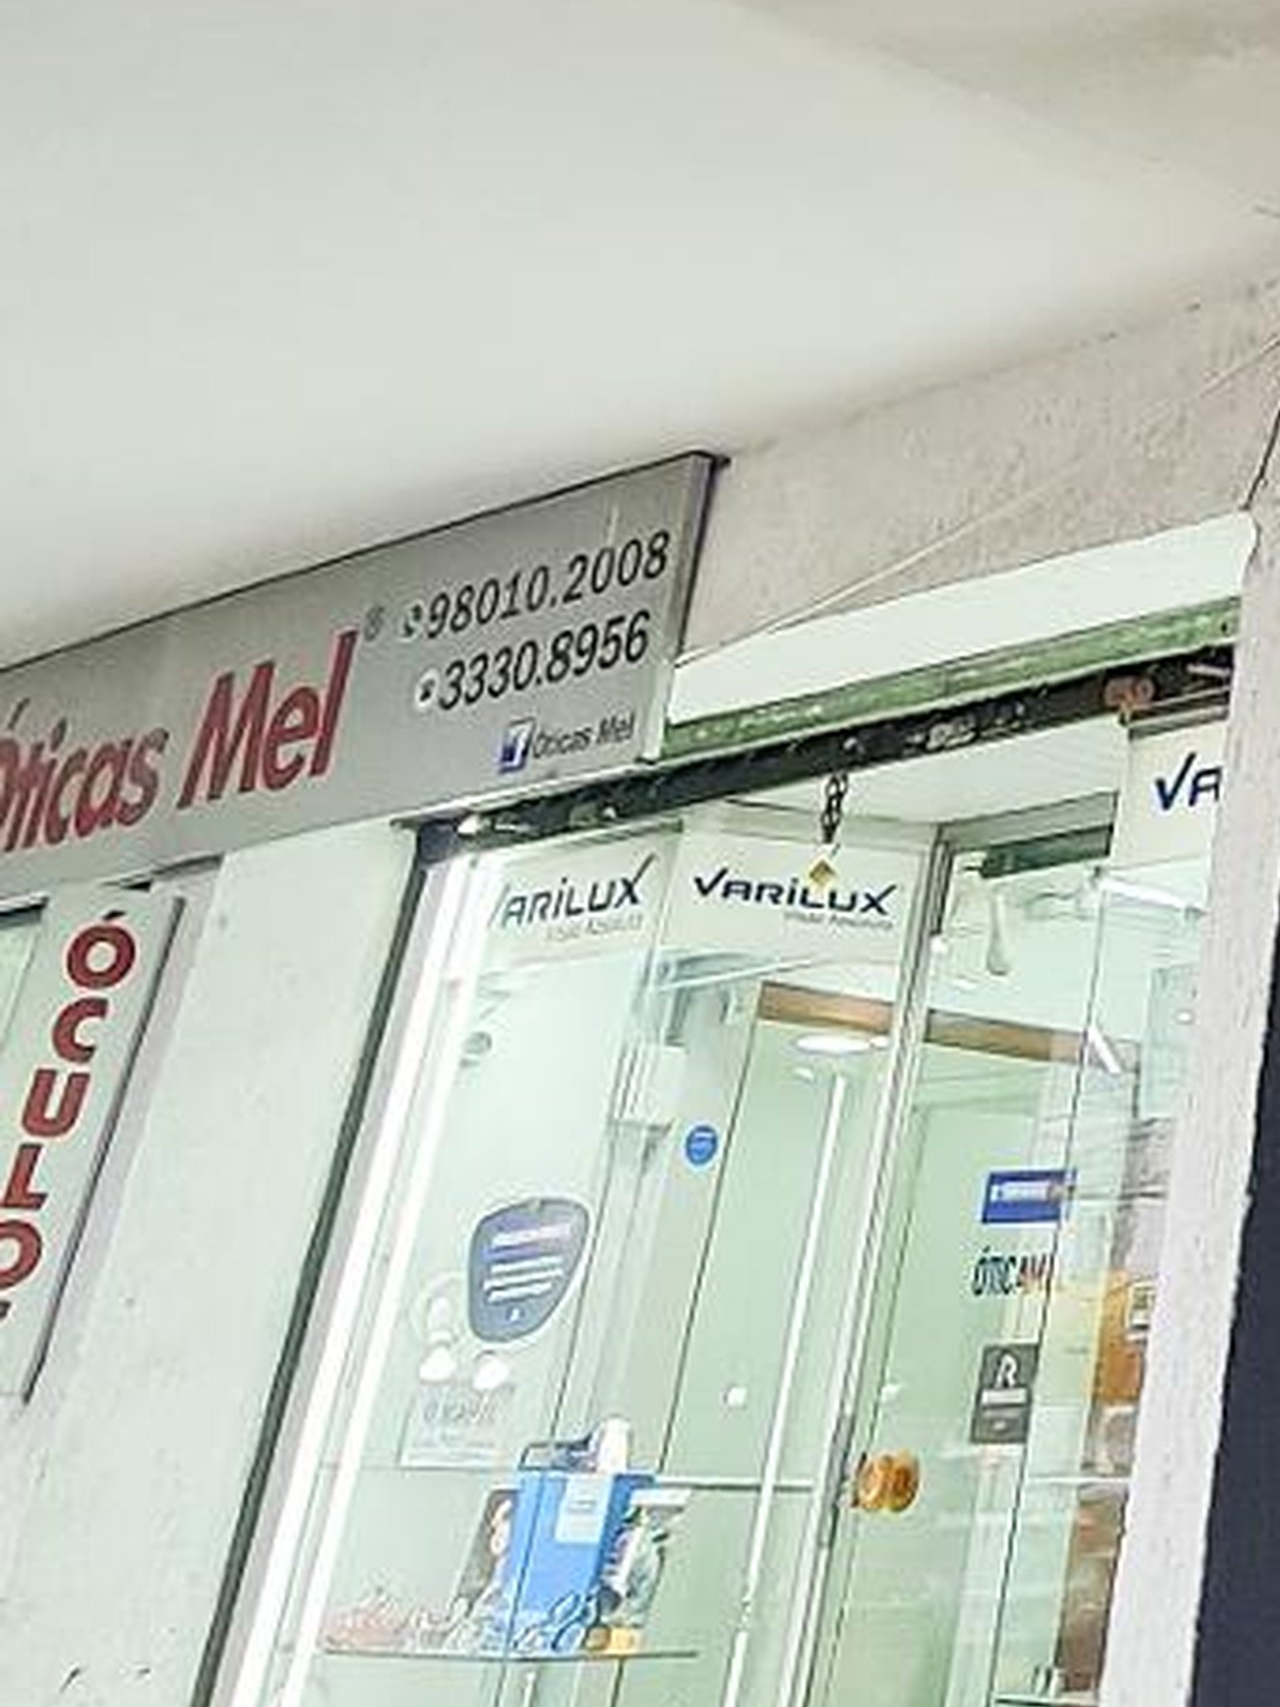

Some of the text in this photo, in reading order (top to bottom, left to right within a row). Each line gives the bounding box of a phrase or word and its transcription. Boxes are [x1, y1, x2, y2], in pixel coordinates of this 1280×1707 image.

[427, 530, 670, 641] 98010.2008
[177, 628, 359, 811] Mel
[437, 610, 652, 711] 3330.8956
[0, 910, 138, 1322] ÓCULO
